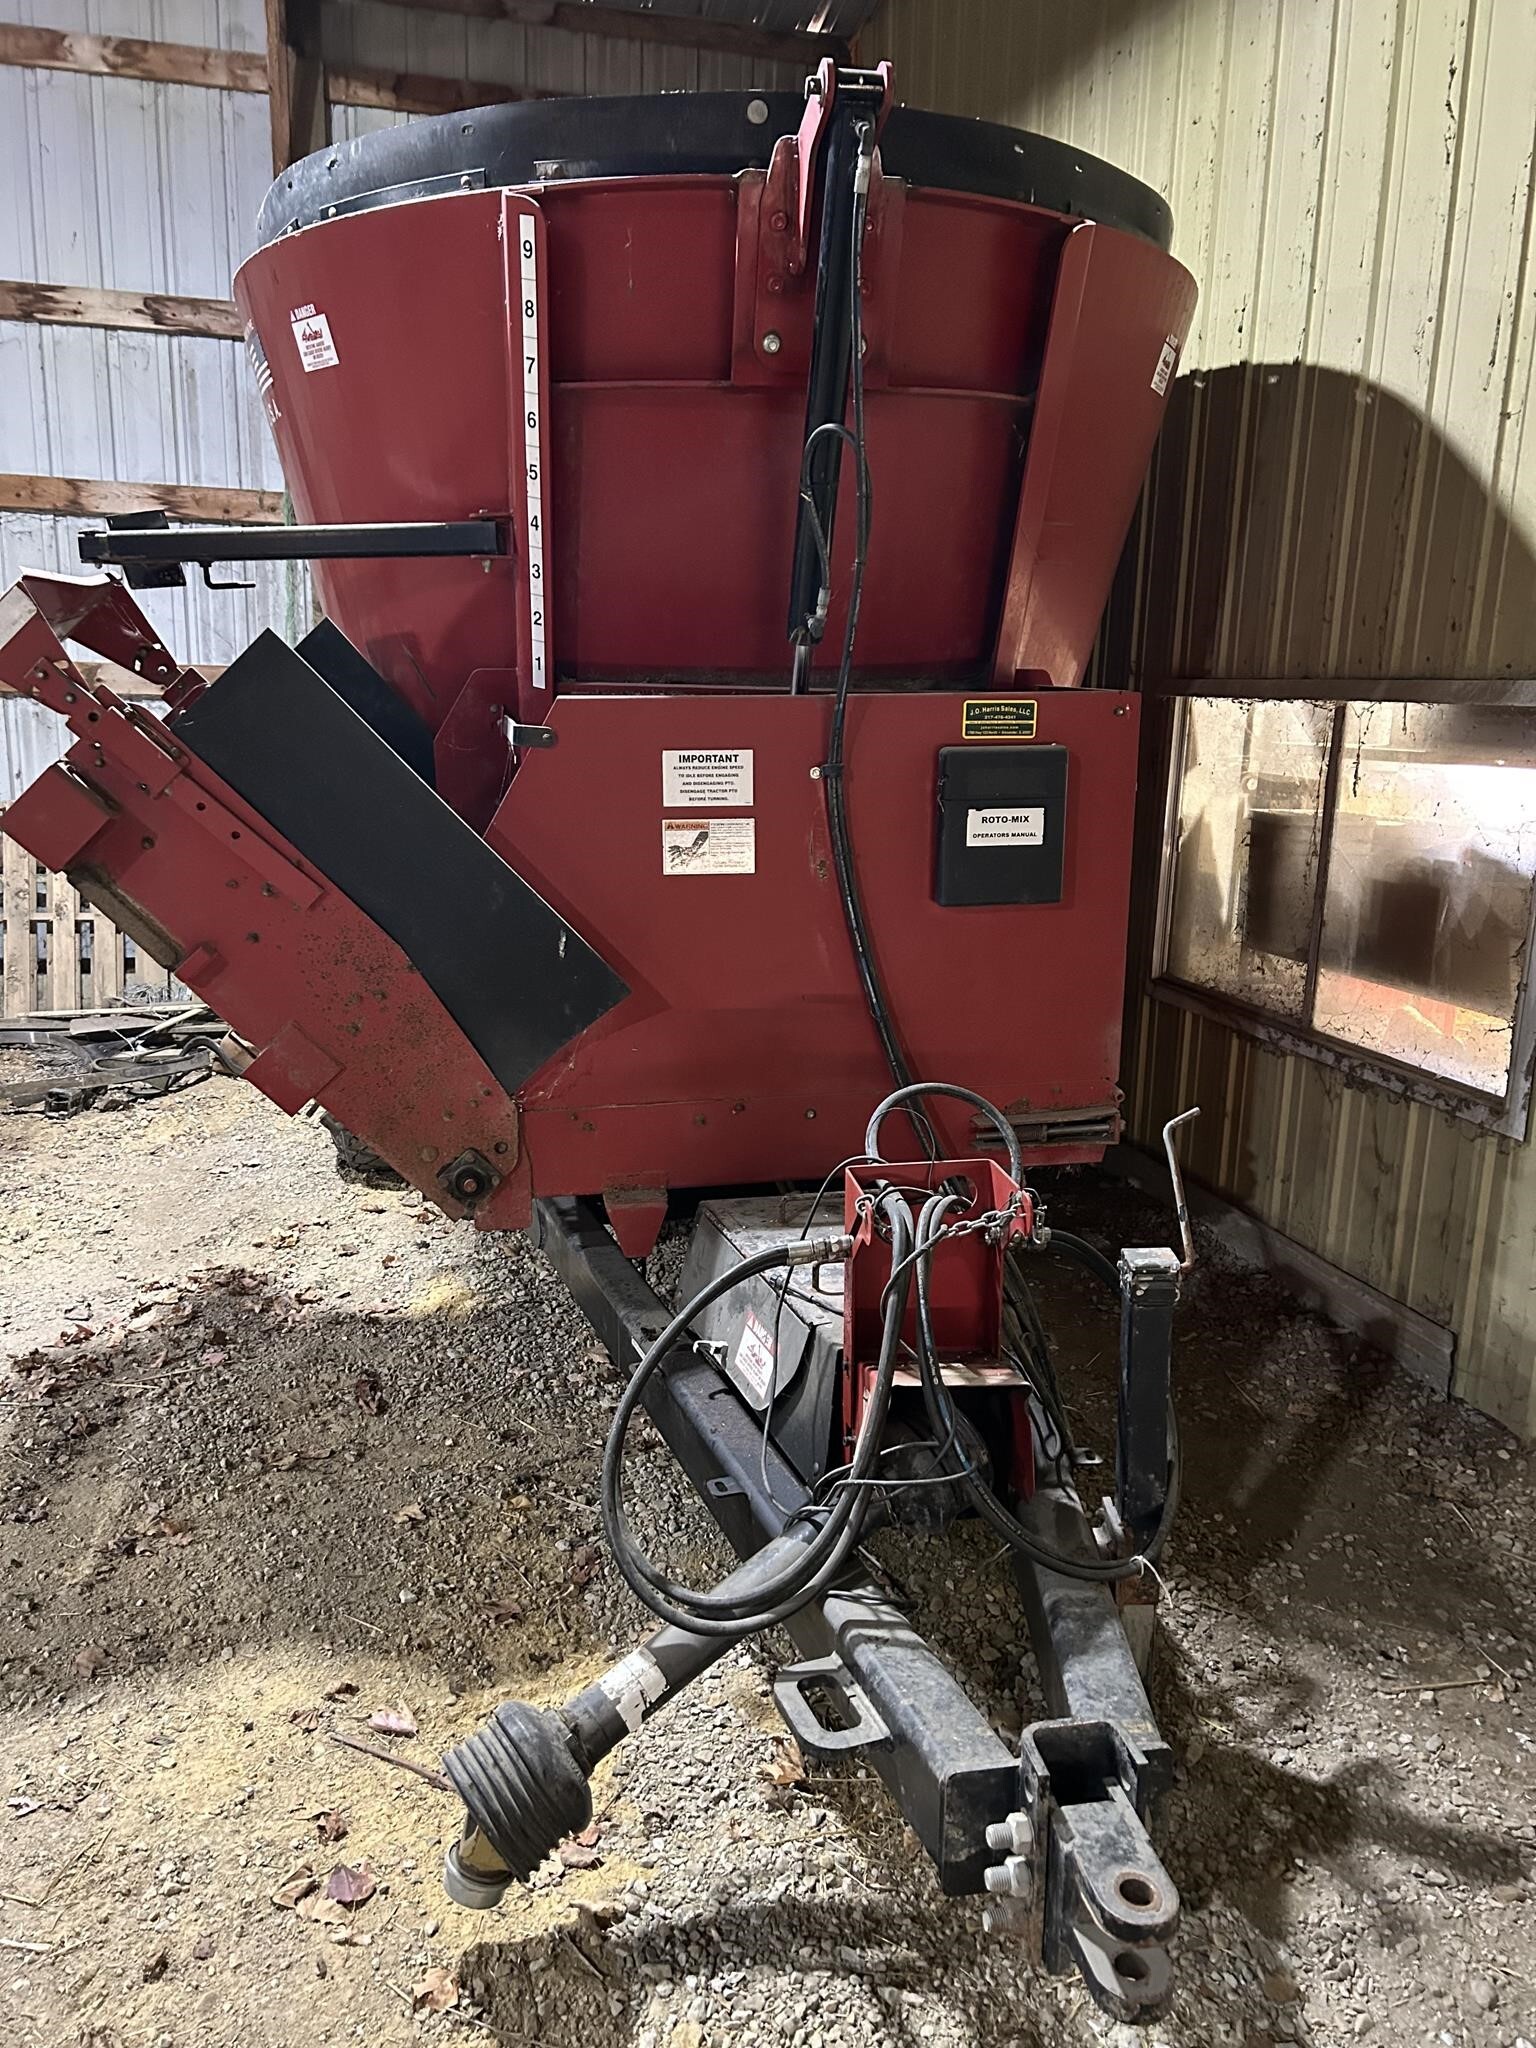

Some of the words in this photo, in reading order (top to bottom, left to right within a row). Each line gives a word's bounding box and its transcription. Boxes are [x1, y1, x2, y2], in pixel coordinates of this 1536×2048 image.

[523, 239, 533, 259] 9
[524, 299, 534, 318] 8
[525, 356, 535, 374] 7
[527, 411, 537, 429] 6
[528, 464, 538, 480] 5
[530, 515, 539, 531] 4
[531, 563, 541, 579] 3
[533, 610, 542, 626] 2
[534, 656, 542, 671] 1
[1018, 707, 1031, 716] LLC
[678, 754, 740, 764] IMPORTANT
[981, 815, 1030, 824] ROTO-MIX
